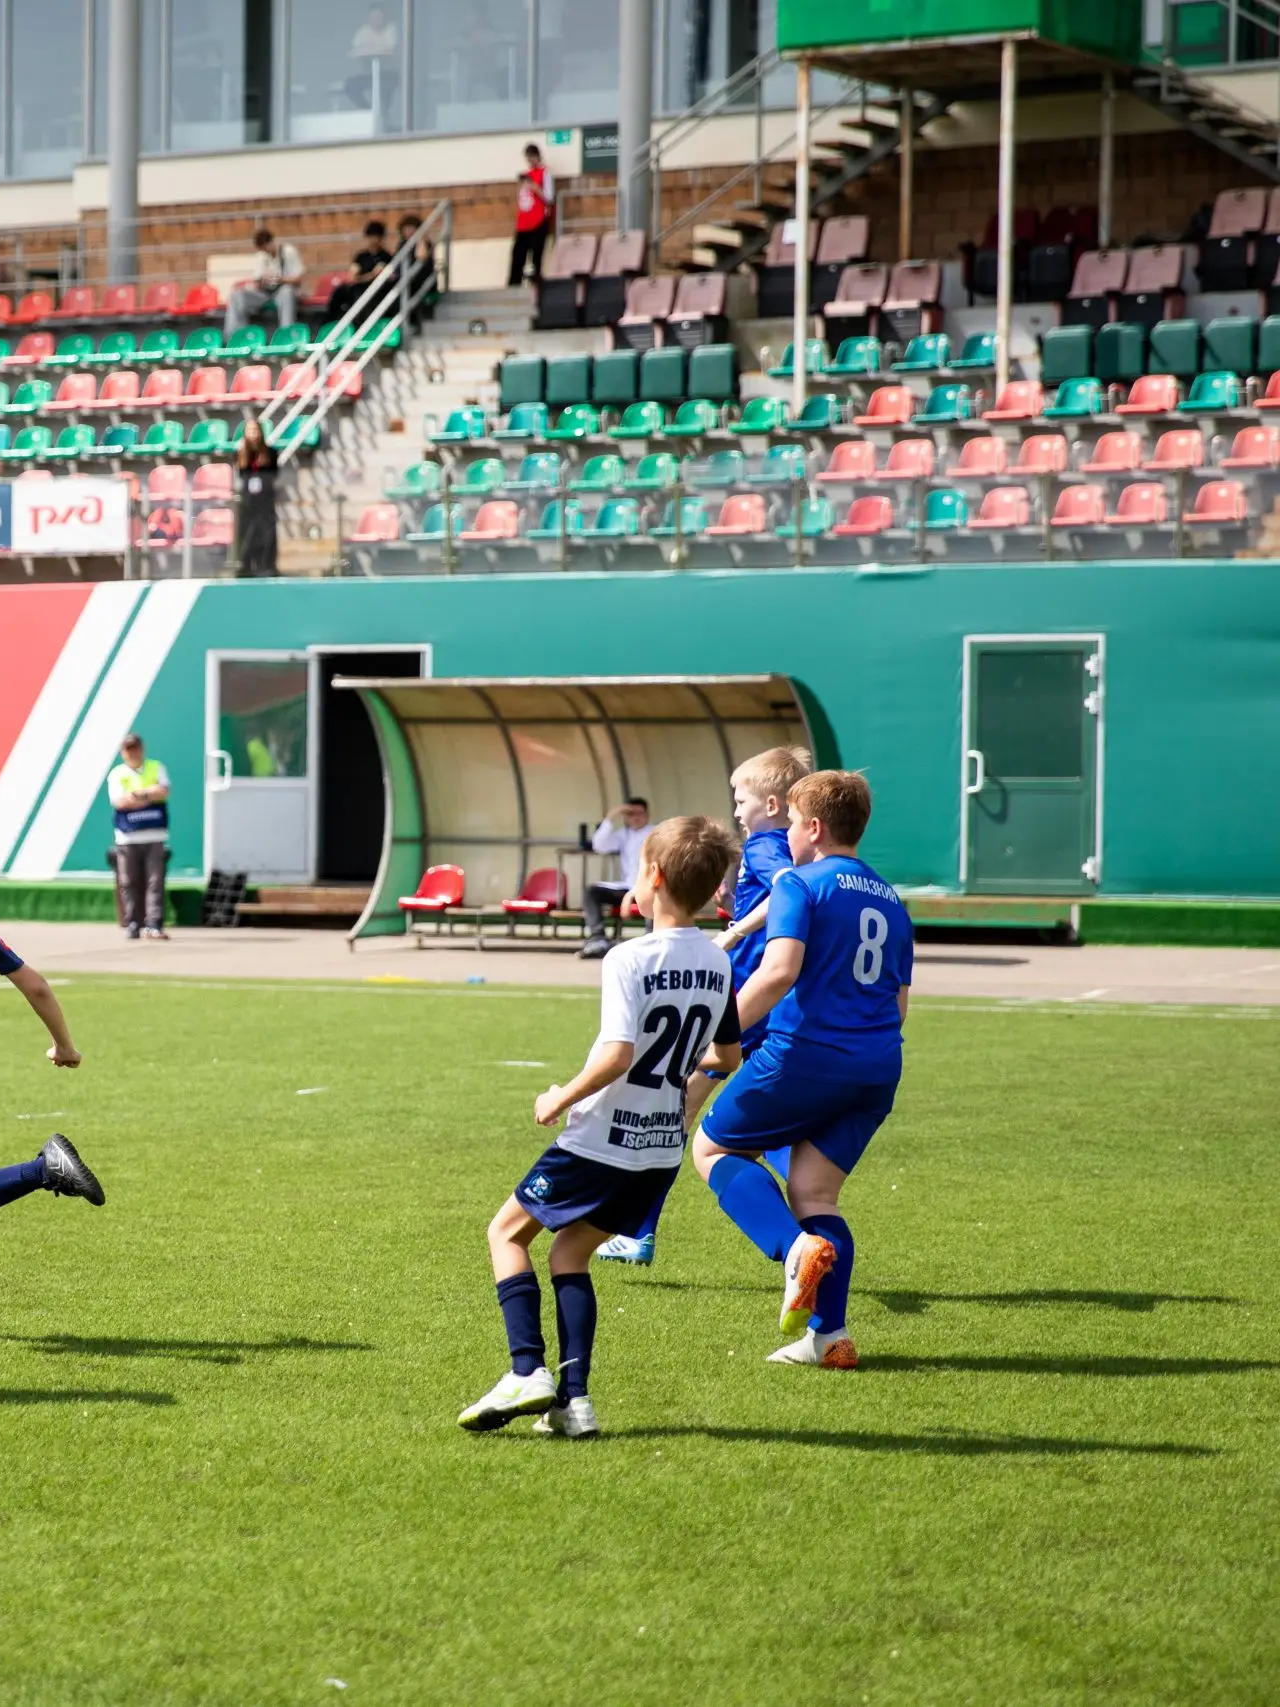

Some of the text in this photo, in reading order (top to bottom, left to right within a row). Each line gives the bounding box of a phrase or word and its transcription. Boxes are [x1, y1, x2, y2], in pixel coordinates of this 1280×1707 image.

[836, 874, 898, 904] ЗАМАЗКИН
[853, 907, 888, 985] 8
[643, 969, 724, 995] НЕВОЛИН
[627, 1004, 712, 1090] 20
[612, 1109, 650, 1129] ЦППФ
